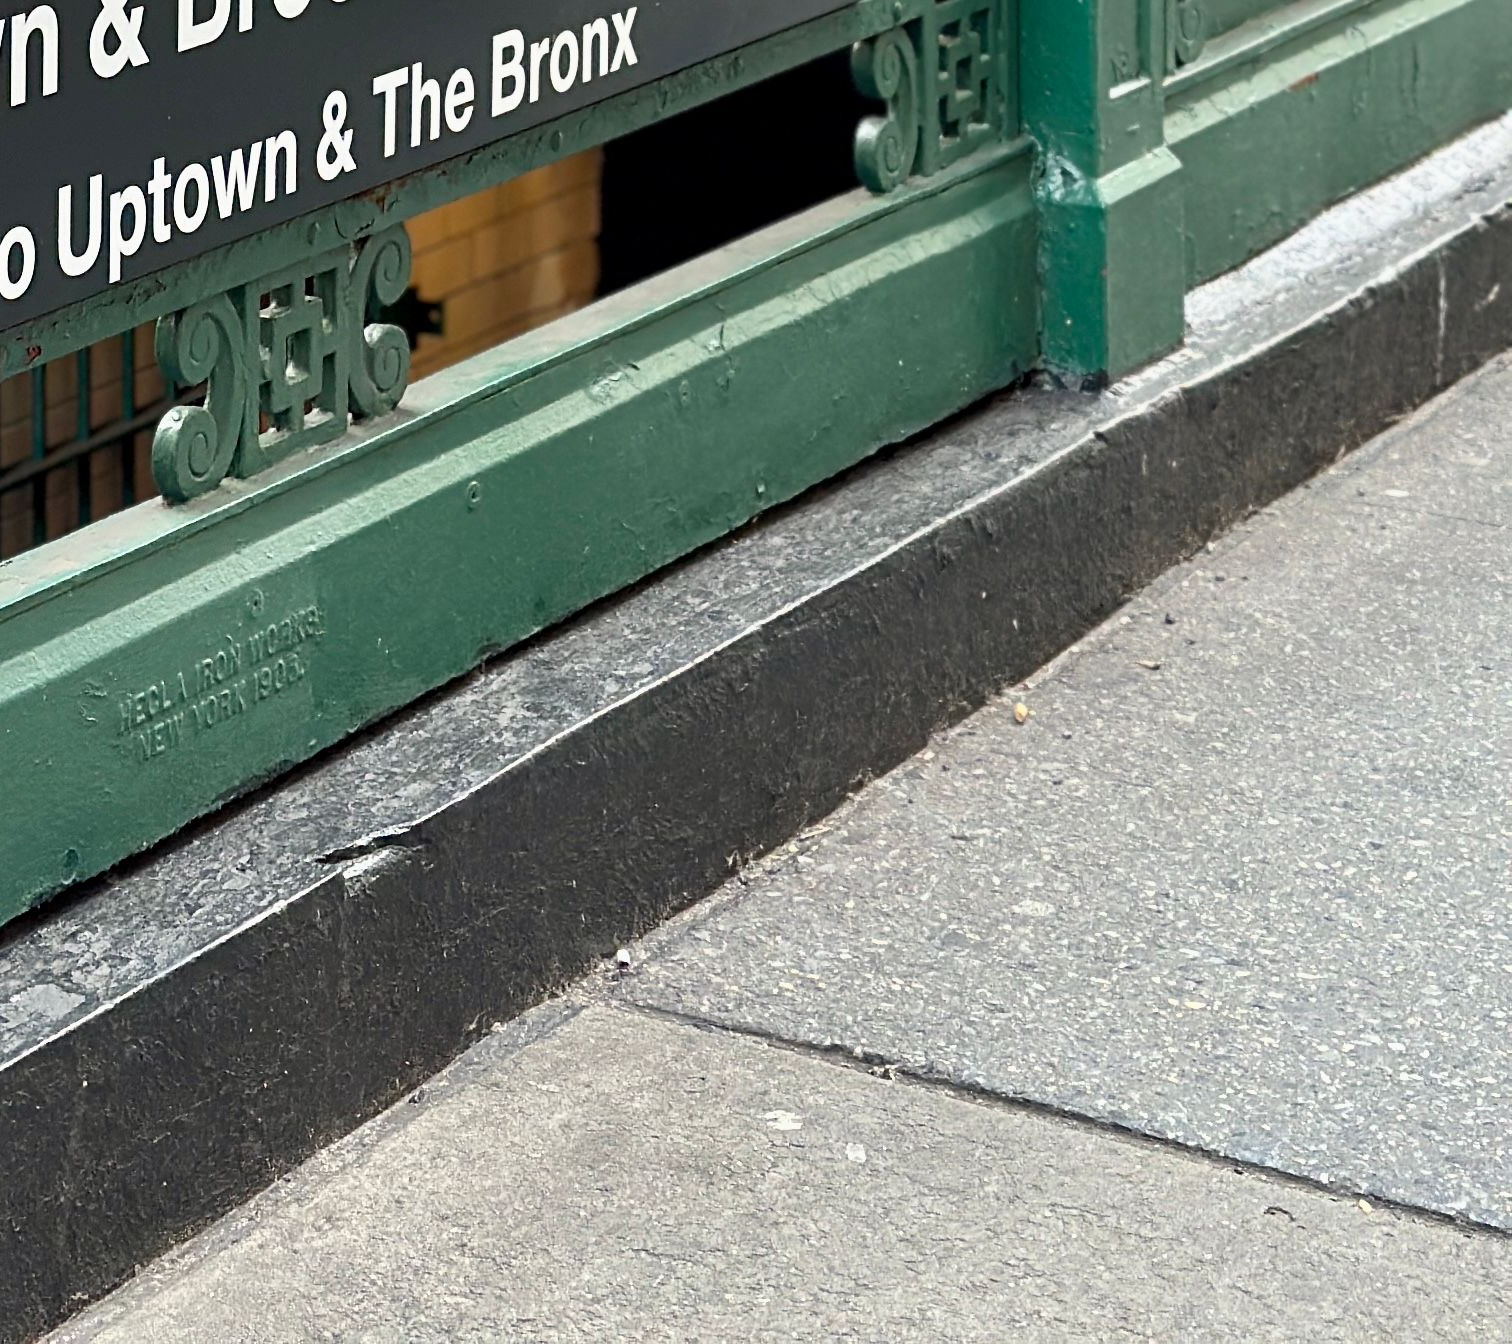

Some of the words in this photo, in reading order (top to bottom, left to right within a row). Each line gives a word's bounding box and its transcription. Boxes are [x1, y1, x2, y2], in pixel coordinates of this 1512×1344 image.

[57, 130, 297, 284] Uptown
[316, 90, 357, 181] &
[372, 61, 475, 158] The
[491, 6, 638, 118] Bronx
